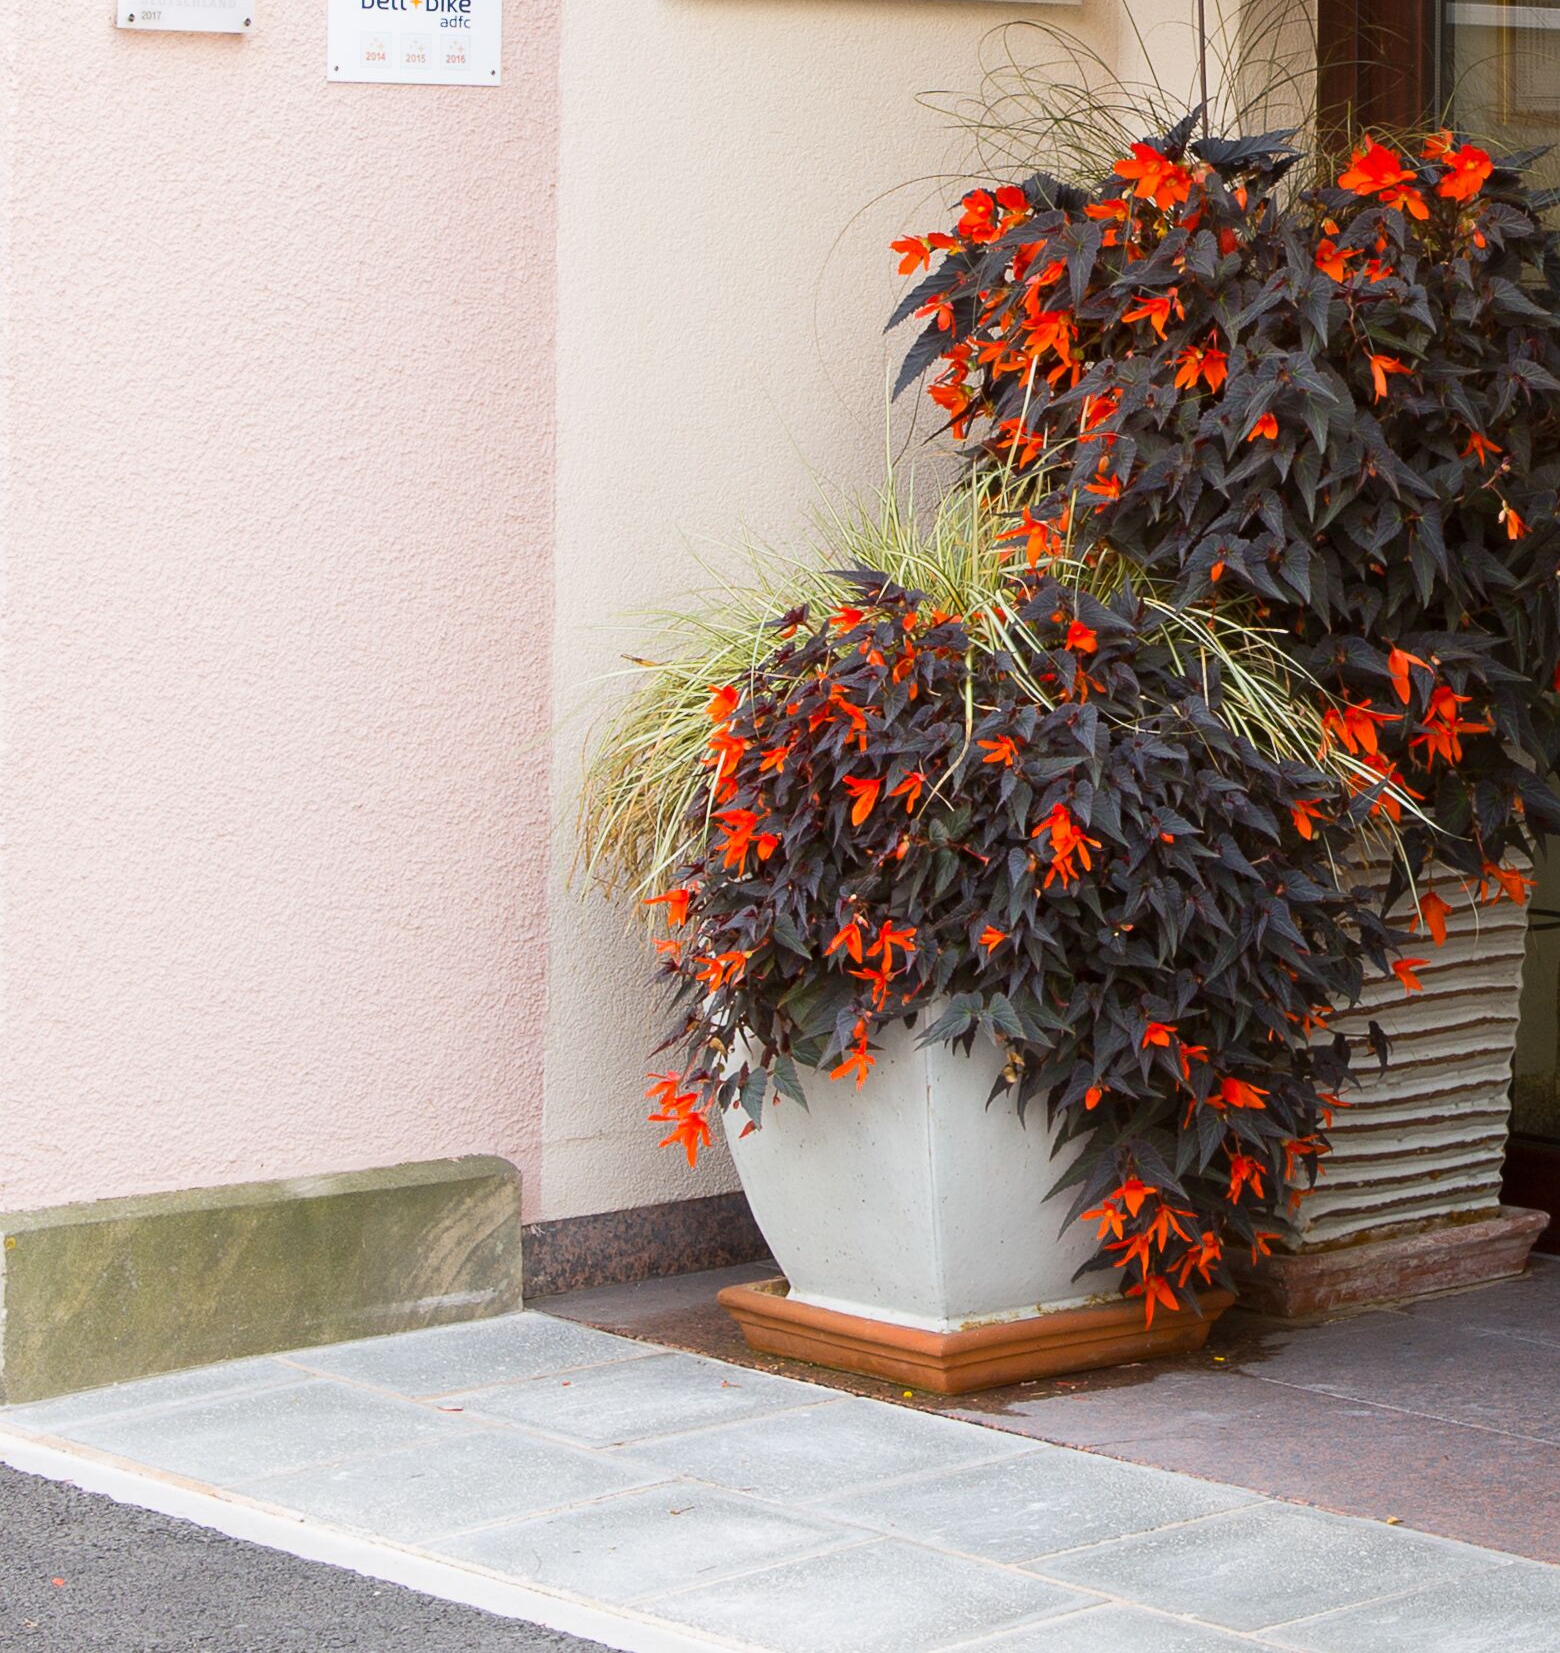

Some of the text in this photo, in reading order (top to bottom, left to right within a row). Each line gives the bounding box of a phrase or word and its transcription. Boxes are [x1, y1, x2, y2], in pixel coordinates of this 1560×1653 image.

[141, 10, 163, 21] 2017
[440, 15, 471, 29] adfc
[365, 52, 467, 64] 2014 2015 2016
